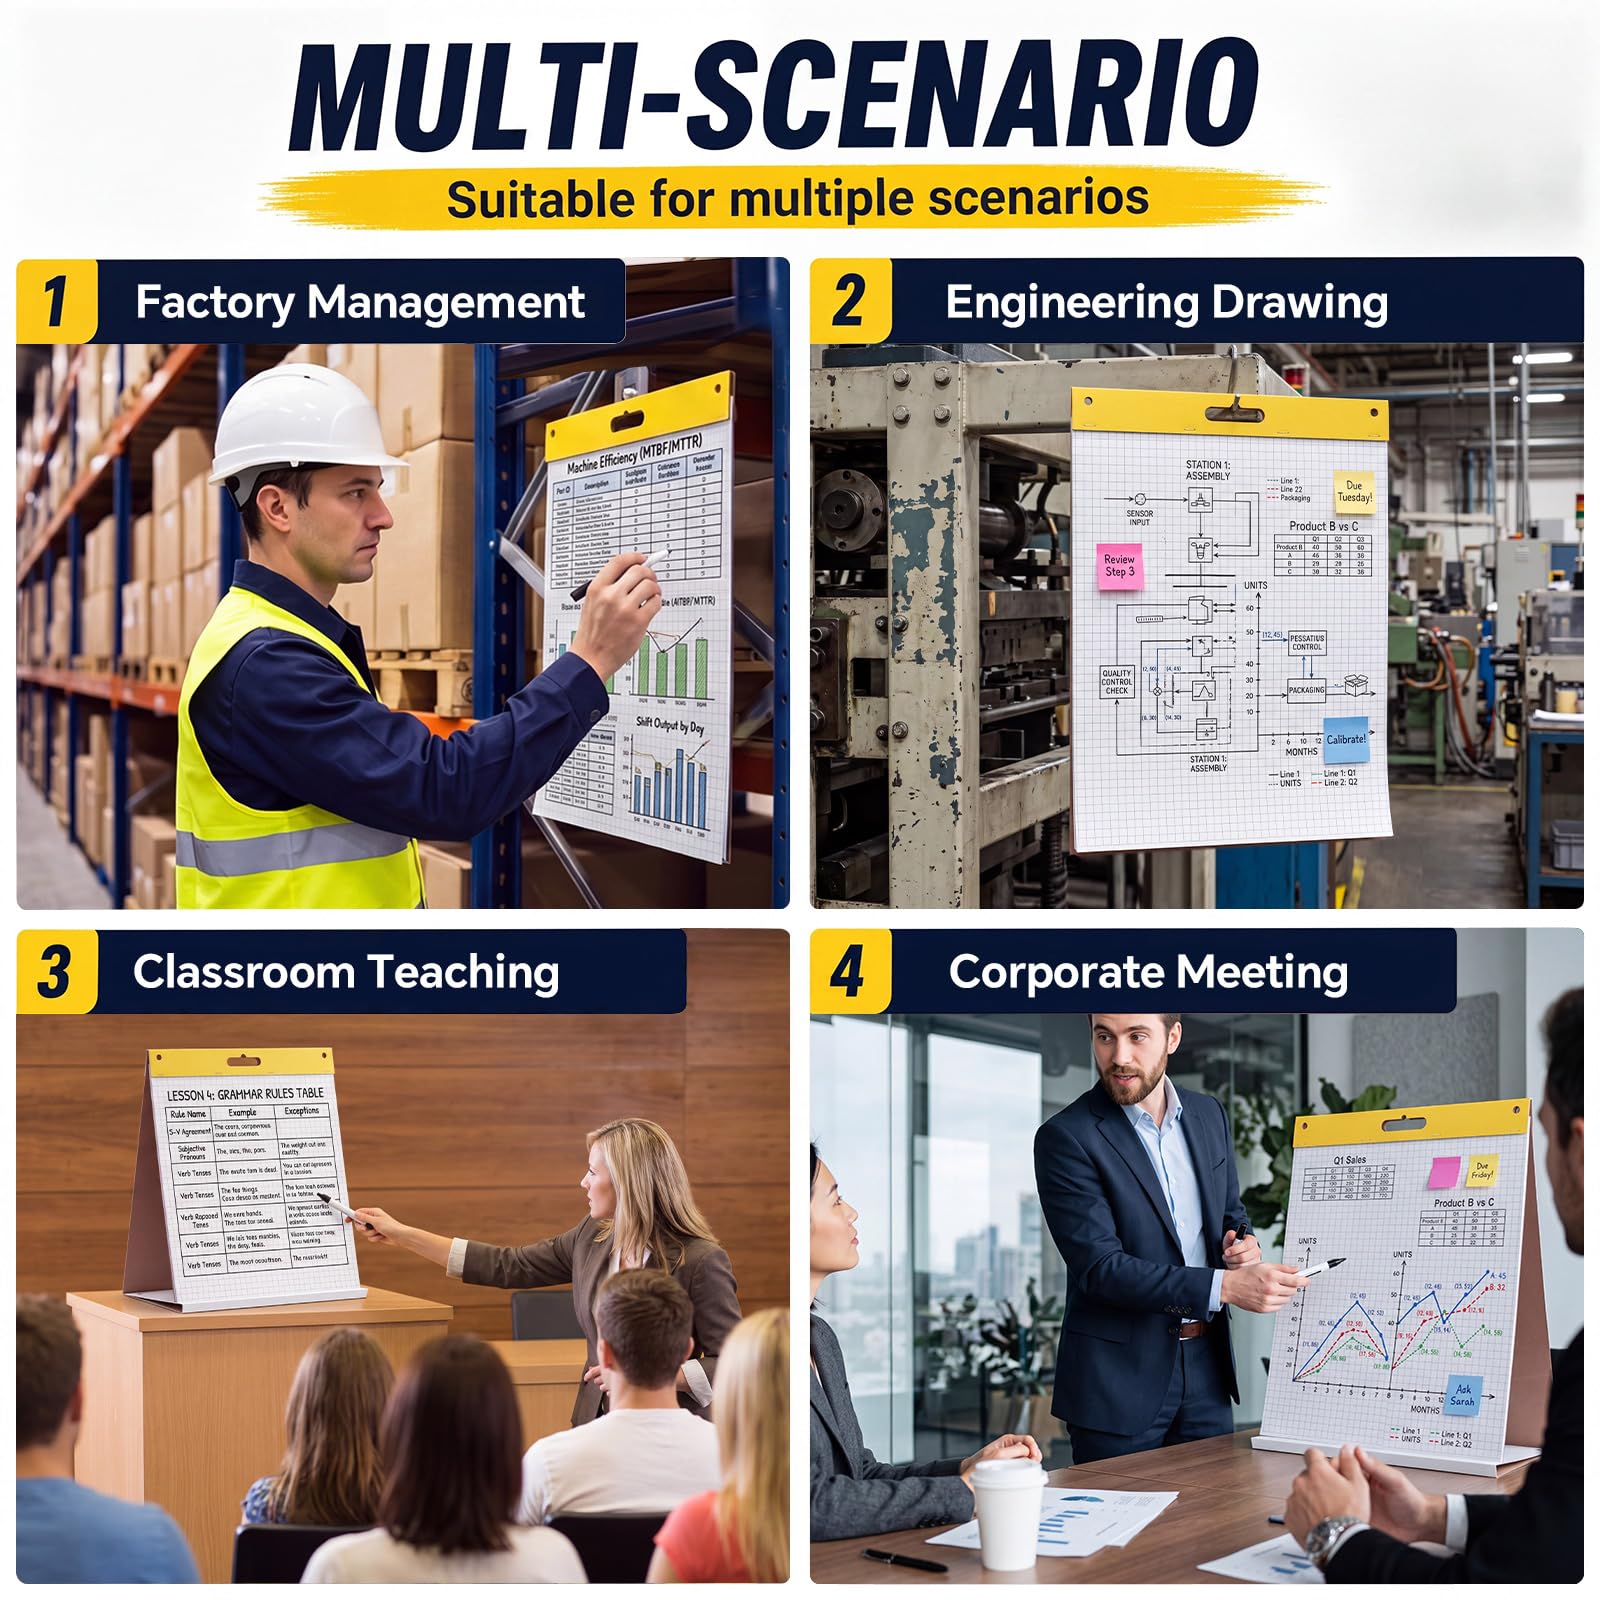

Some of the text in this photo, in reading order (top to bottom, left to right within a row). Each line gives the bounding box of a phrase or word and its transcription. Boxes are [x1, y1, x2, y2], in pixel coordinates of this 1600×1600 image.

[568, 433, 702, 474] Machine Efficiency (MTBF/MTTR)
[1186, 460, 1231, 470] STATION 1:
[1186, 471, 1231, 480] ASSEMBLY
[1347, 480, 1362, 490] Due
[1280, 494, 1310, 502] Packaging
[1338, 492, 1373, 504] Tuesday!
[1290, 521, 1326, 531] Product
[1329, 521, 1336, 531] B
[1352, 522, 1359, 531] C
[1104, 554, 1135, 564] Review
[1105, 567, 1135, 579] Step 3
[1244, 581, 1268, 589] UNITS
[1289, 686, 1325, 694] PACKAGING
[637, 716, 704, 737] Shift Output by Day
[1327, 735, 1366, 744] Calibrate!
[1286, 748, 1318, 756] MONTHS
[1347, 769, 1356, 777] Q1
[1348, 778, 1357, 786] Q2
[167, 1087, 324, 1101] LESSON 4: GRAMMAR RULES TABLE
[228, 1108, 257, 1117] Example
[285, 1106, 319, 1115] Exceptions
[178, 1145, 206, 1153] Subjective
[1346, 1156, 1366, 1164] Sales
[1476, 1162, 1488, 1170] Due
[1472, 1170, 1494, 1179] Friday!
[1434, 1199, 1465, 1207] Product
[1468, 1198, 1474, 1206] B
[1488, 1198, 1494, 1206] C
[1450, 1396, 1475, 1406] Sarah
[1411, 1406, 1440, 1414] MONTHS
[1402, 1436, 1421, 1444] UNITS
